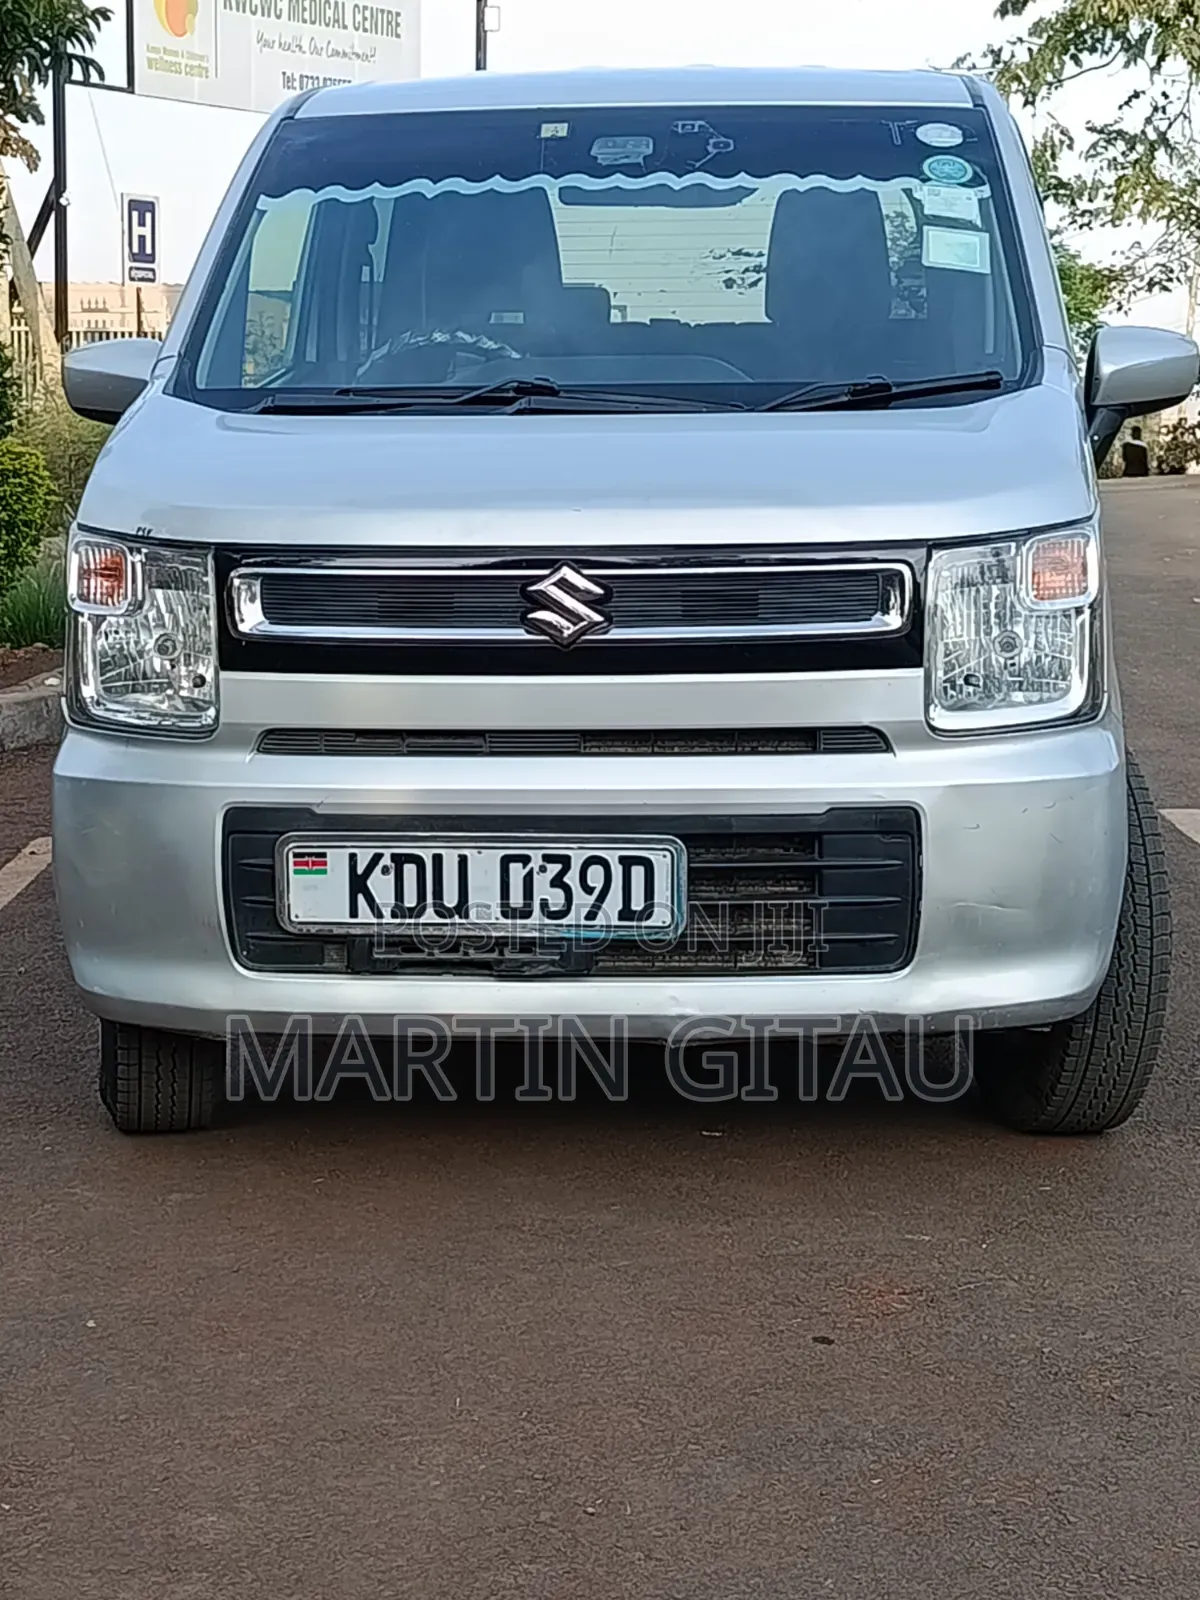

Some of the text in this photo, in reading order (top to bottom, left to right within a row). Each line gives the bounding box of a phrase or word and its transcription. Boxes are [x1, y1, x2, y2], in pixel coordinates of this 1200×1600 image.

[287, 0, 348, 30] MEDICAL
[352, 3, 402, 39] CENTRE
[256, 29, 276, 54] Your
[309, 36, 324, 56] Our
[131, 210, 152, 255] H
[348, 852, 470, 919] KDU
[500, 853, 655, 922] 039D
